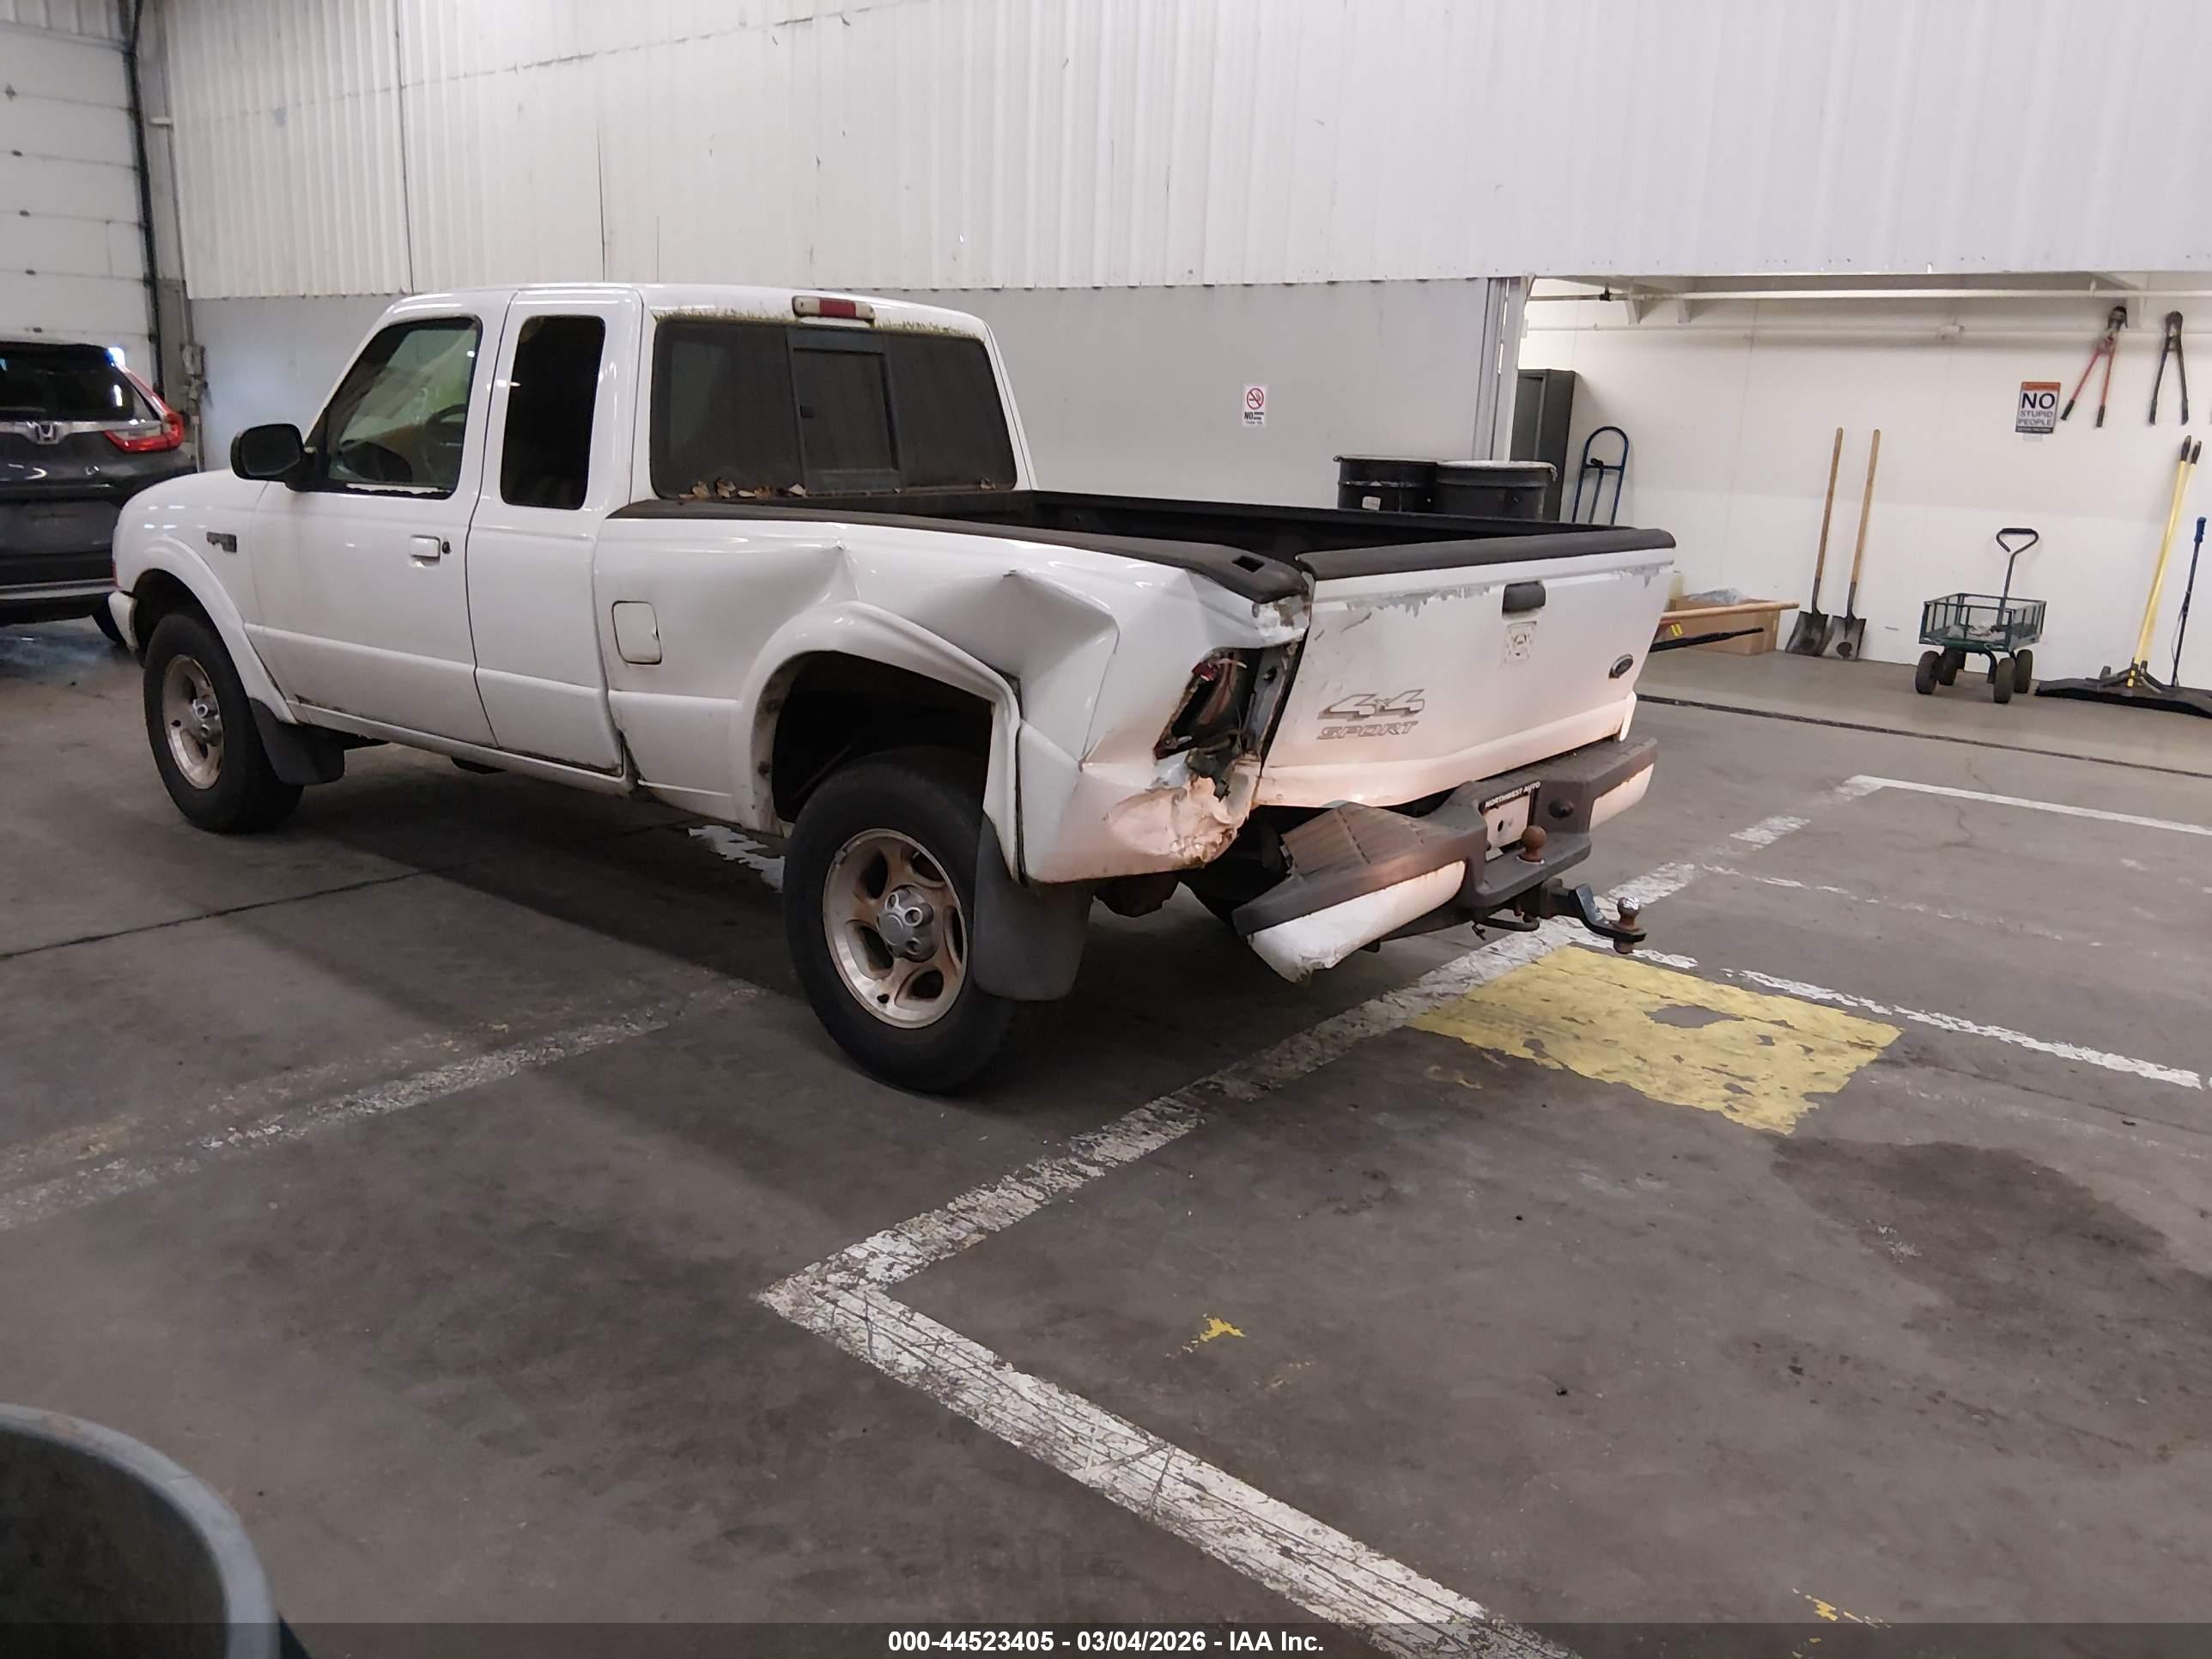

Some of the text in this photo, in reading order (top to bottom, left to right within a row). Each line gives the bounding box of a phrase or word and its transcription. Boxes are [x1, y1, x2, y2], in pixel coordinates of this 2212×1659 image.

[2021, 392, 2055, 409] NO
[1244, 411, 1254, 420] NO
[1316, 720, 1419, 740] SPORT
[1485, 781, 1540, 808] NORTHWEST AUTO
